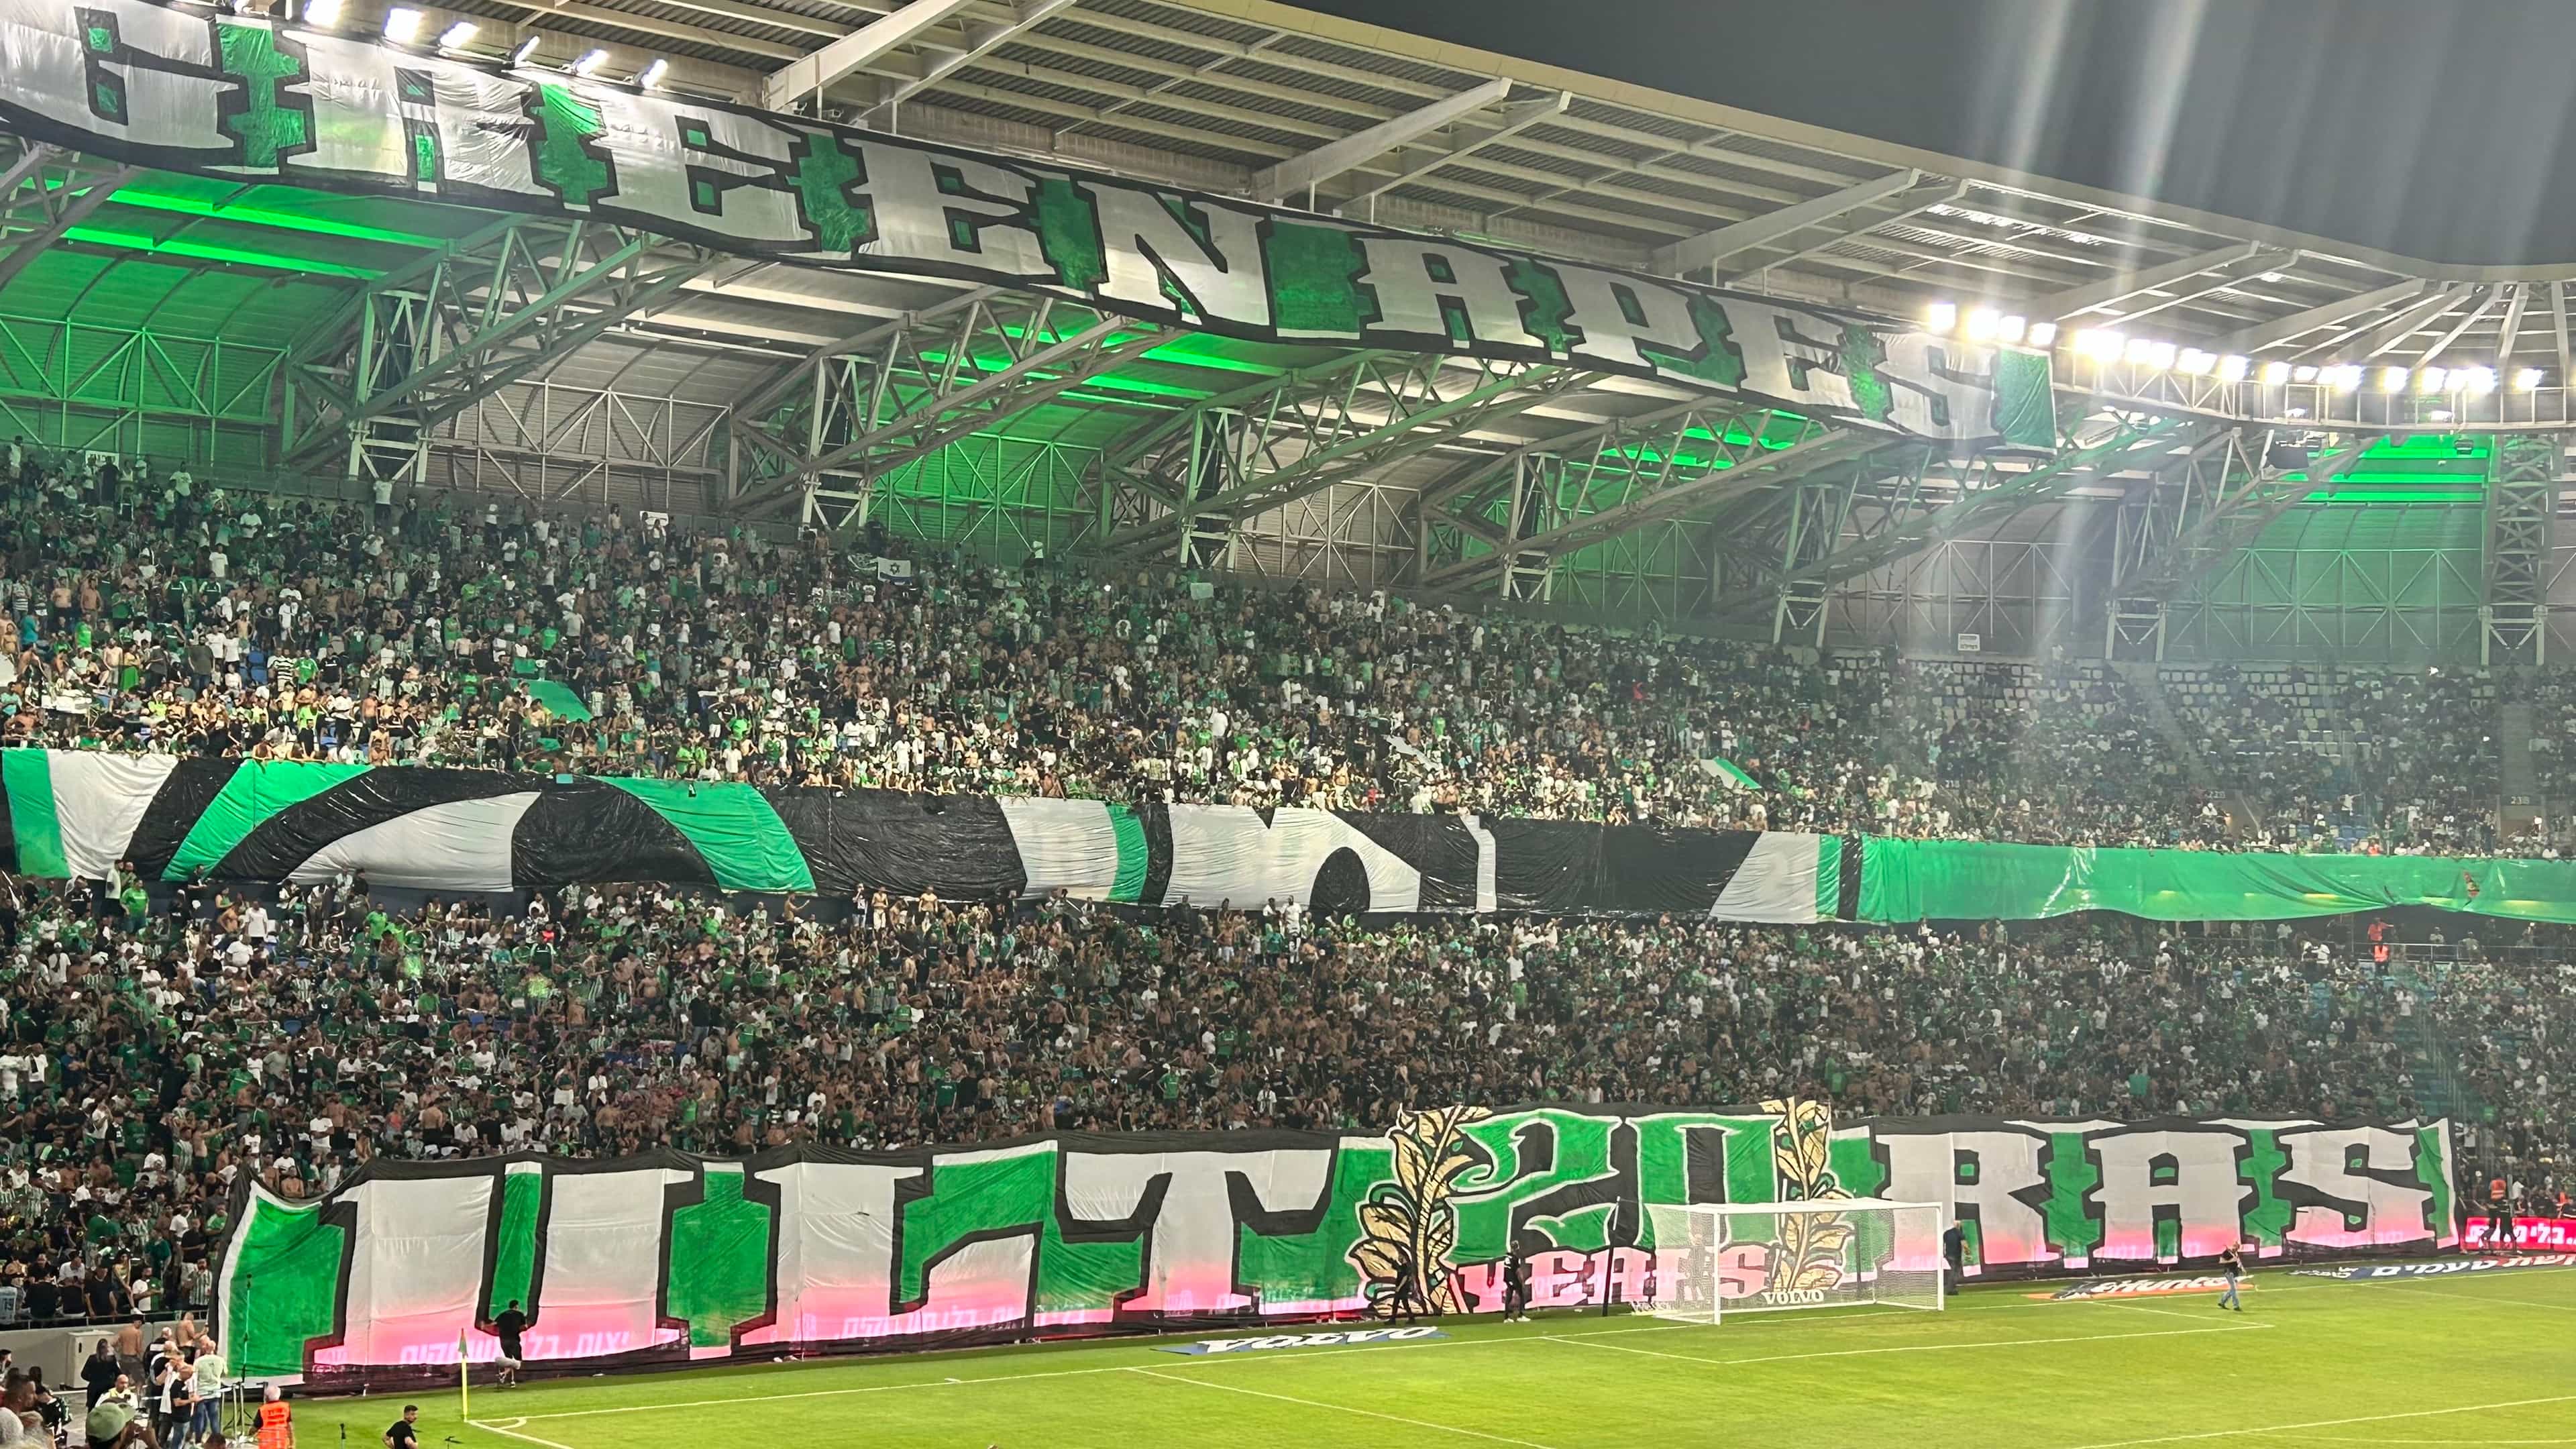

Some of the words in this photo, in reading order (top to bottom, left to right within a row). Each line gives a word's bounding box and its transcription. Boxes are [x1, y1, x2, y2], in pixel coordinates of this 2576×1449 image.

[0, 0, 1271, 326] GREEN
[1356, 236, 2003, 440] APES
[1761, 1289, 1825, 1305] VOLVO
[1196, 1326, 1438, 1353] VOLVO
